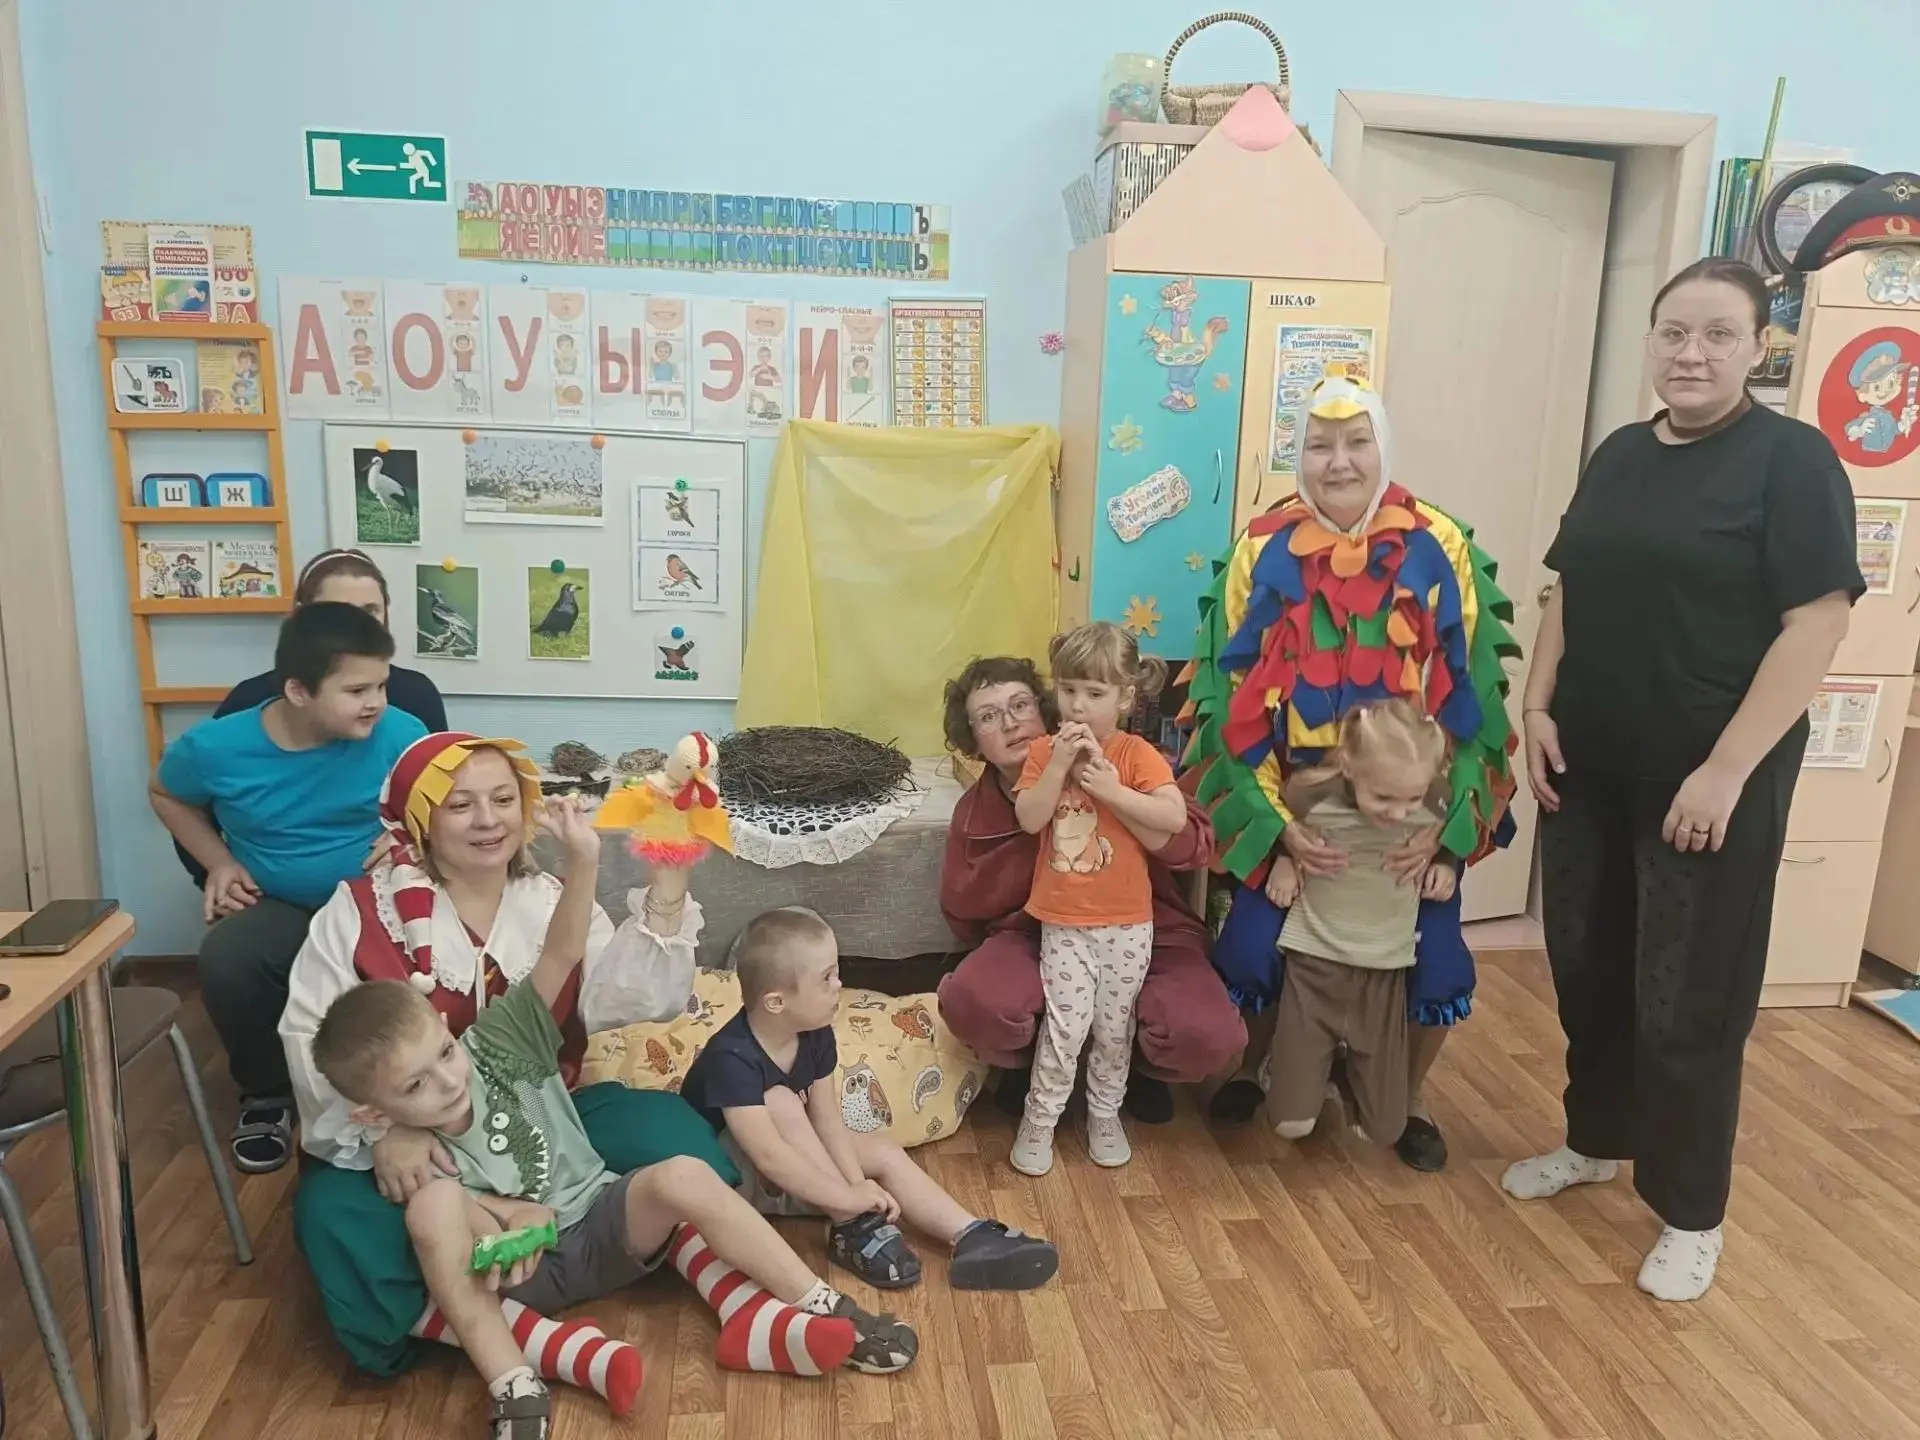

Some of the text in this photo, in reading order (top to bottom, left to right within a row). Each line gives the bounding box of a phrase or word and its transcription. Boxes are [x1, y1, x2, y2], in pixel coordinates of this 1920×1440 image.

[1269, 294, 1316, 306] ШКАФ
[289, 303, 342, 395] А
[391, 312, 446, 391] О
[496, 315, 543, 392] У
[598, 325, 643, 395] Ы
[701, 329, 745, 402] Э
[799, 327, 839, 423] И
[226, 487, 245, 502] Ж
